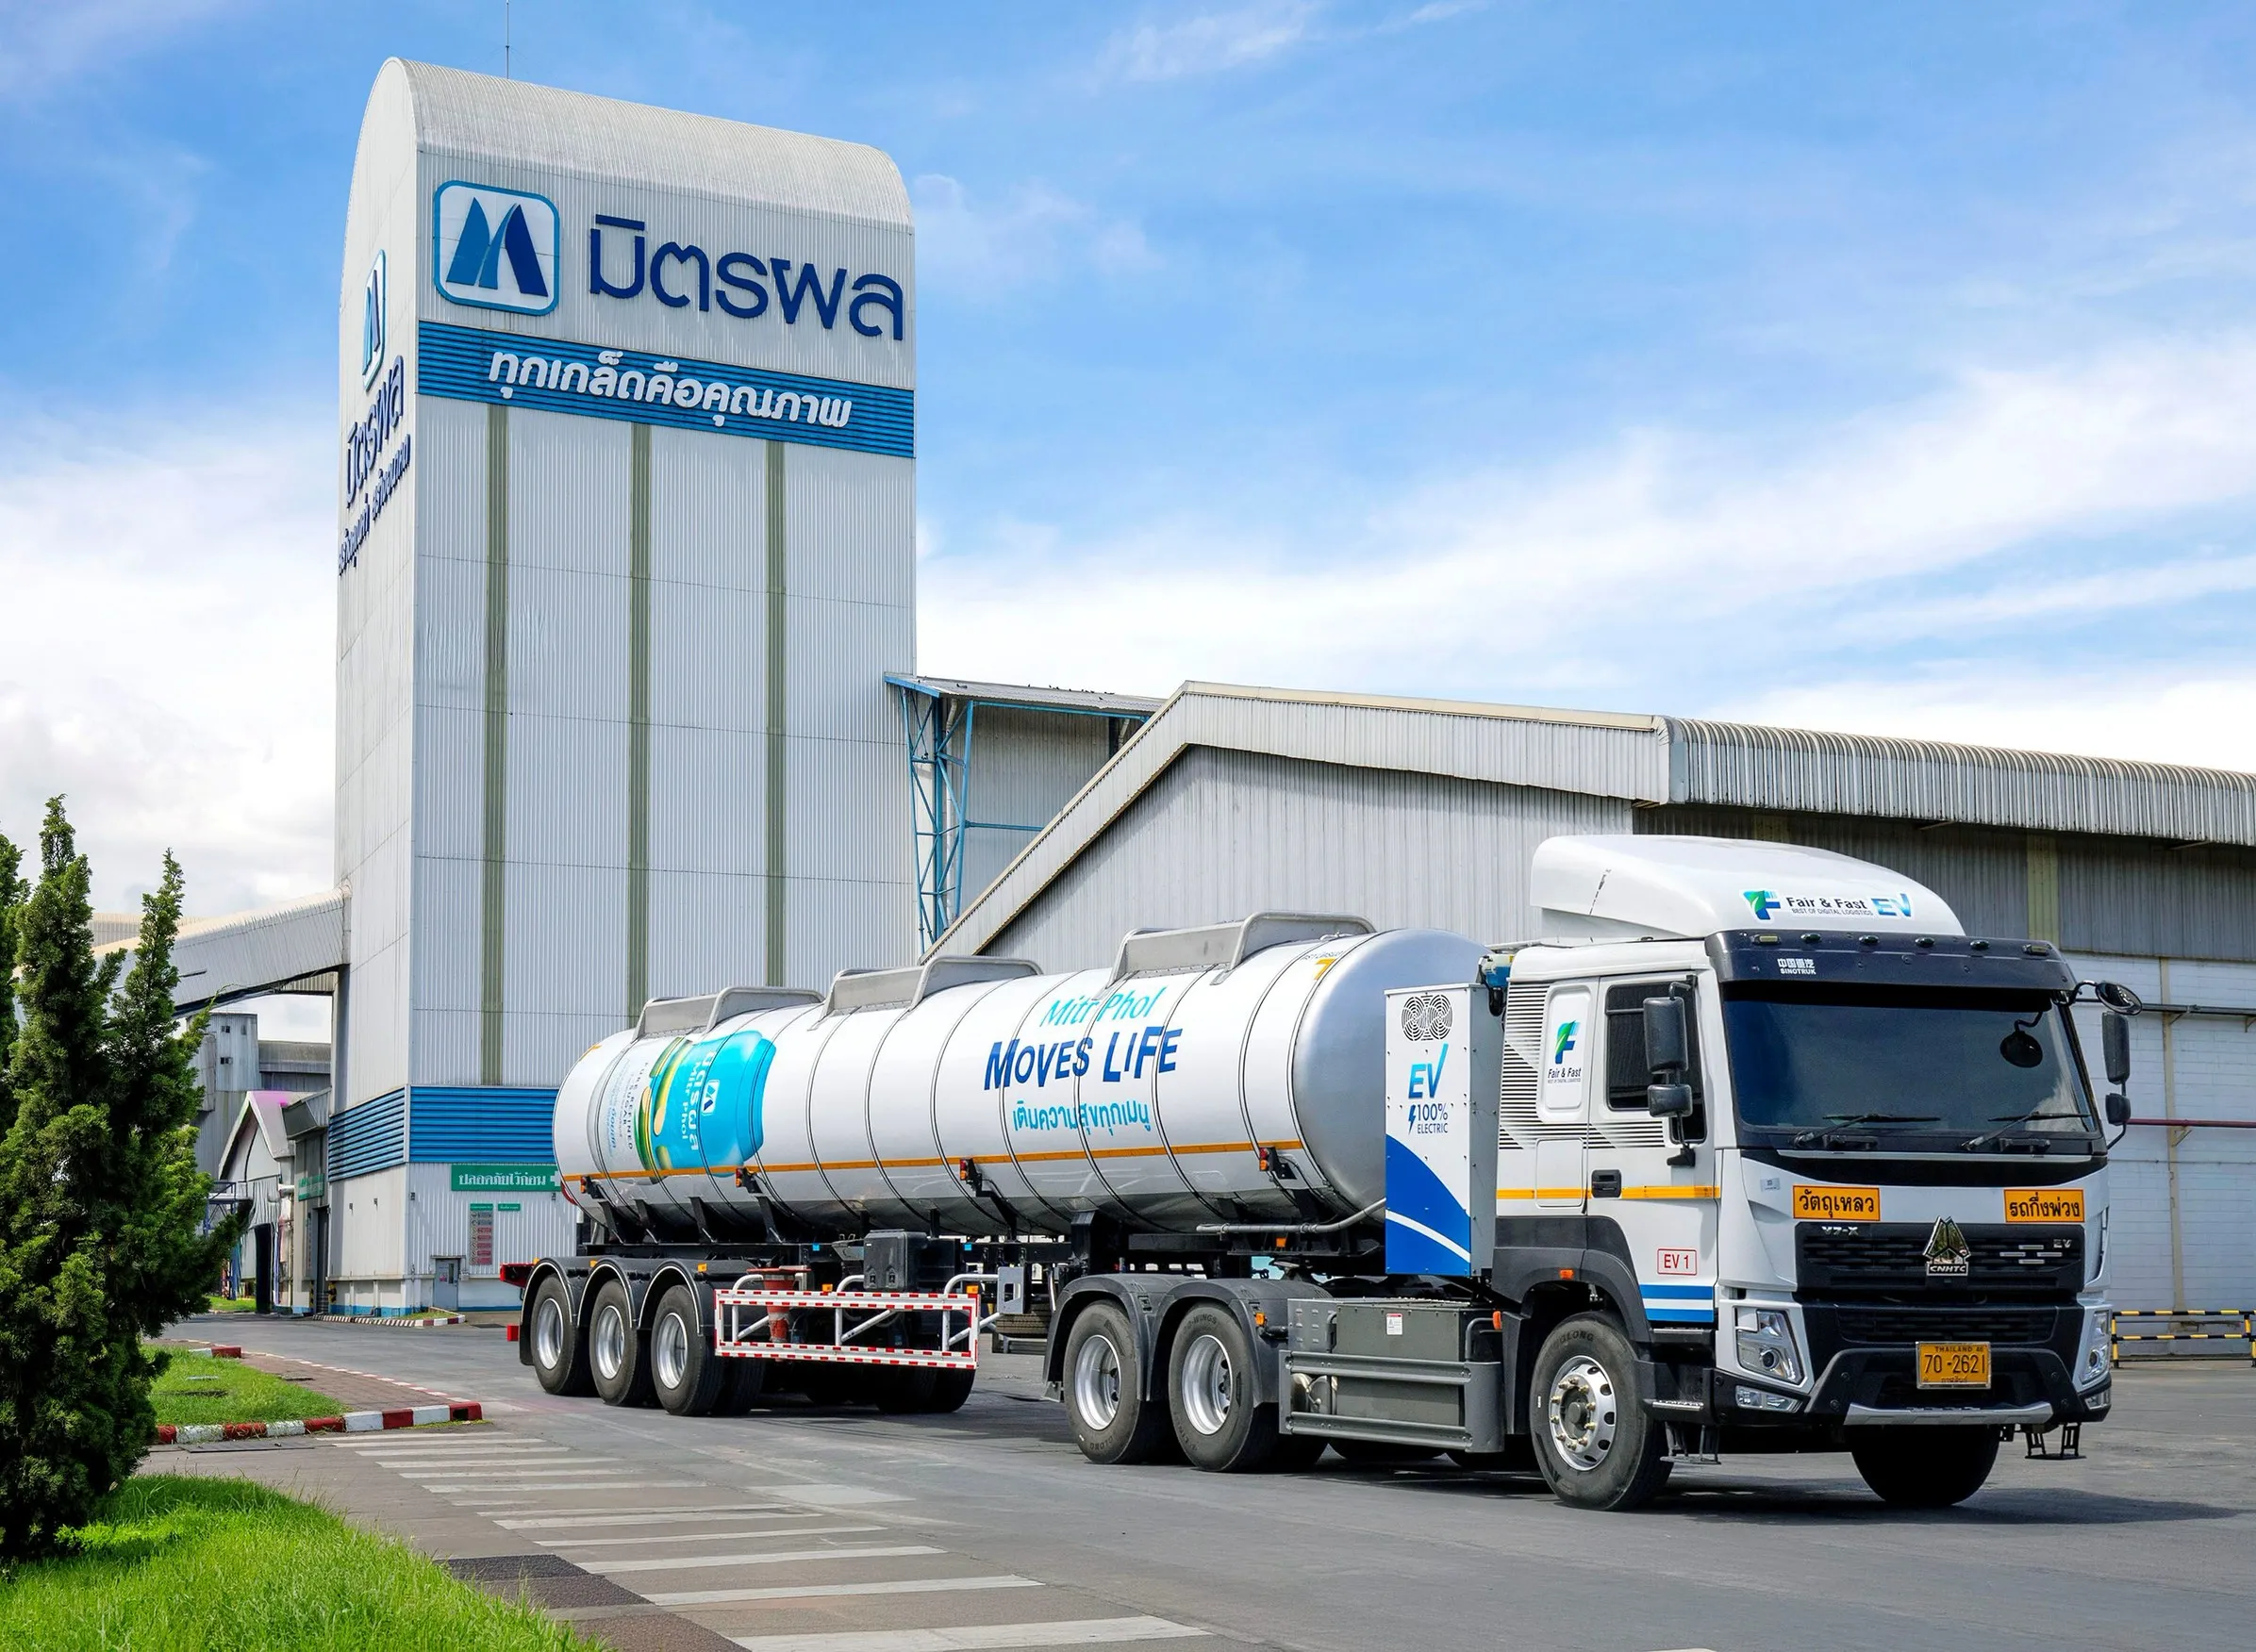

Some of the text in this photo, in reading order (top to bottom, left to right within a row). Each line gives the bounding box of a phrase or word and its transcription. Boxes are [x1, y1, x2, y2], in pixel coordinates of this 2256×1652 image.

[489, 350, 853, 427] ทุกเกล็ดคือคุณภาพ
[1786, 897, 1867, 909] Fair & Fast
[1871, 893, 1912, 917] EV
[1039, 986, 1169, 1028] Mitr Phol
[984, 1026, 1183, 1091] MOVES LIFE
[1408, 1043, 1449, 1099] EV
[1548, 1067, 1560, 1079] Fair
[1568, 1067, 1581, 1078] Fast
[1013, 1100, 1152, 1136] เติมความสุขทุกเมนู
[1418, 1103, 1449, 1121] 100%
[1417, 1123, 1449, 1134] ELECTRIC
[458, 1172, 546, 1186] ปลอดภัยไว้ก่อน
[1799, 1189, 1874, 1218] วัตถุเหลว
[2009, 1192, 2080, 1217] รถกึ่งพ่วง
[2053, 1239, 2072, 1248] EV
[1664, 1254, 1689, 1269] EV 1
